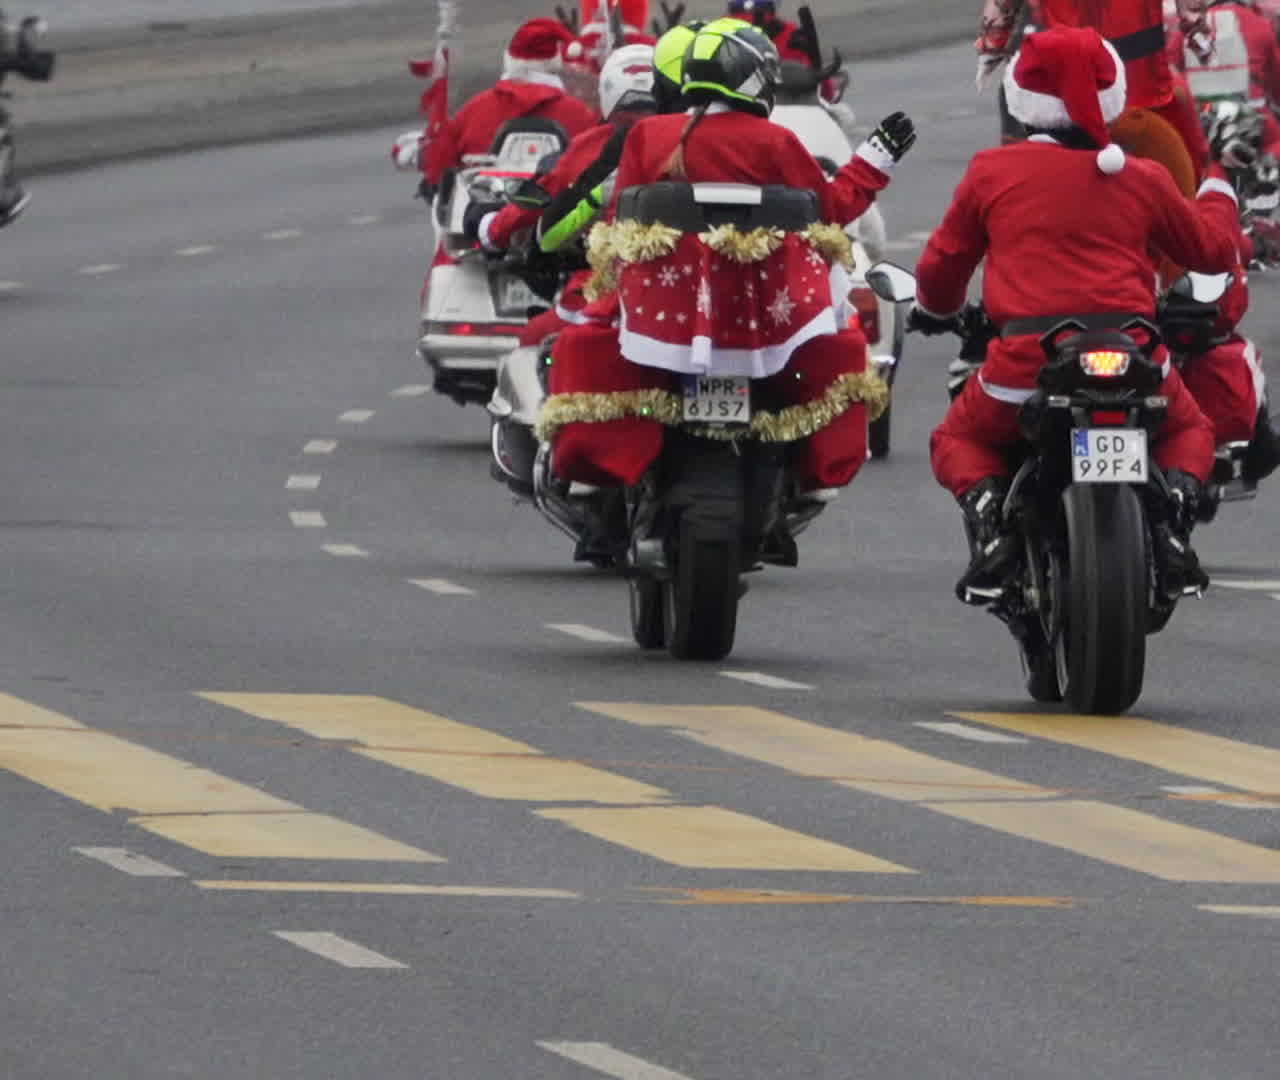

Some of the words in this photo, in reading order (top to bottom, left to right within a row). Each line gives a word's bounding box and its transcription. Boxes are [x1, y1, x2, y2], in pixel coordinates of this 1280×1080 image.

[688, 400, 744, 417] 6JS7
[1096, 435, 1126, 454] GD
[1080, 459, 1142, 477] 99F4
